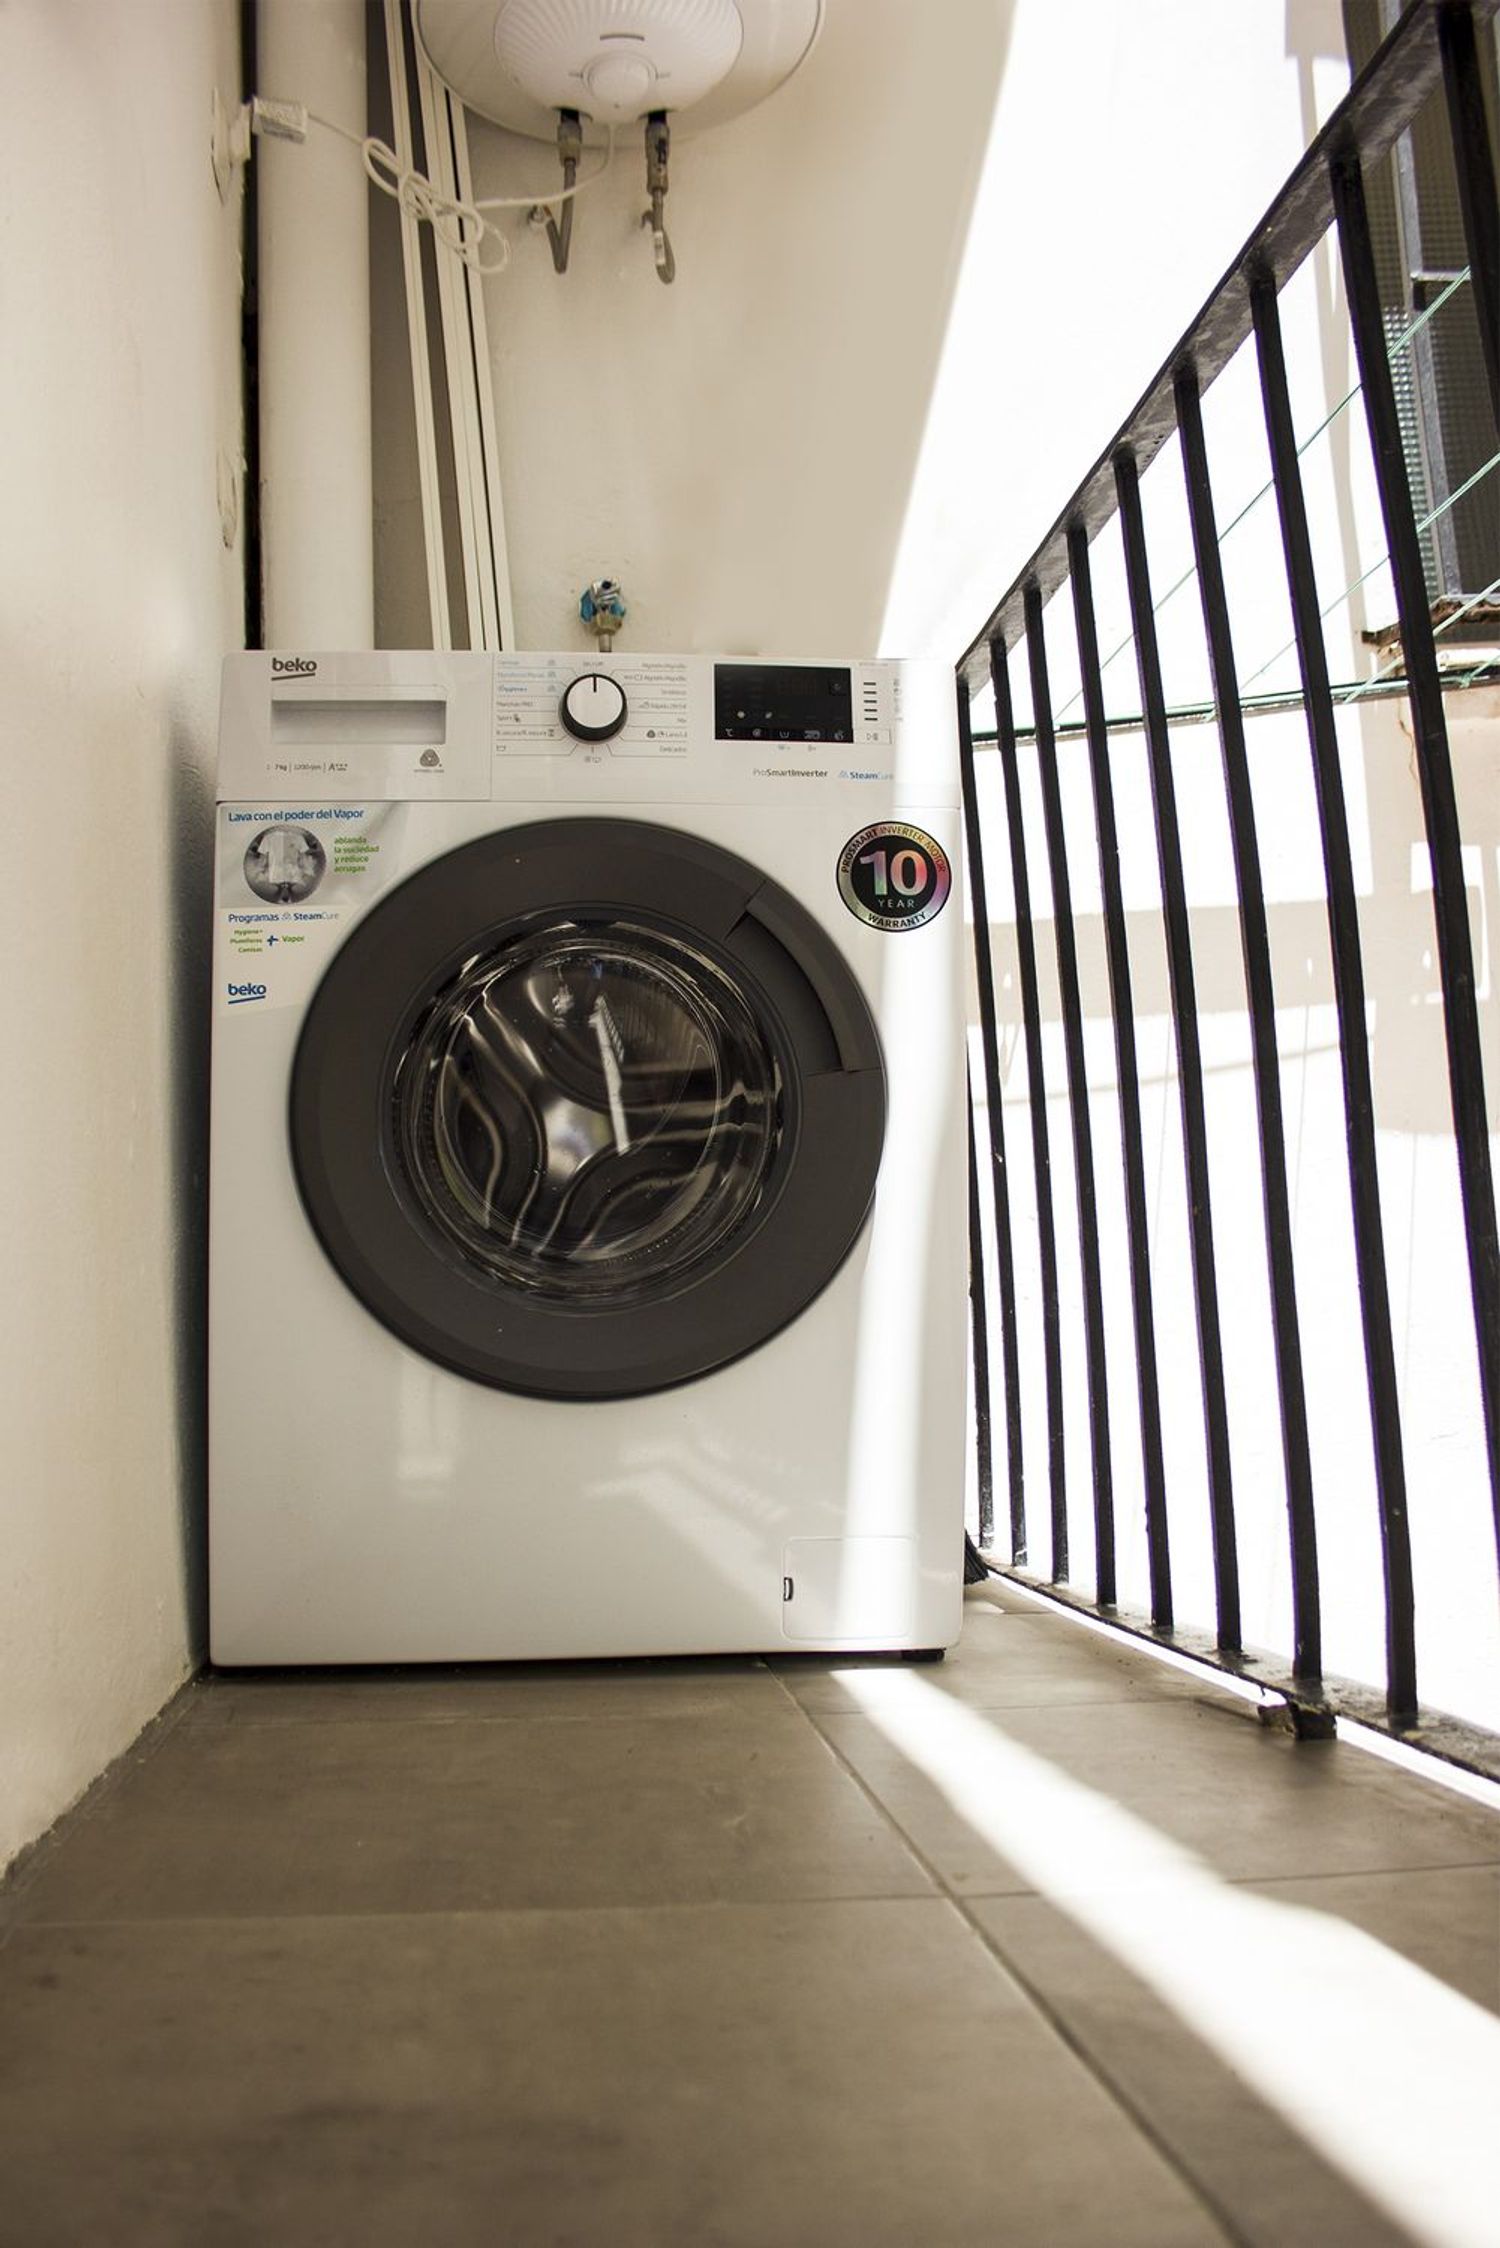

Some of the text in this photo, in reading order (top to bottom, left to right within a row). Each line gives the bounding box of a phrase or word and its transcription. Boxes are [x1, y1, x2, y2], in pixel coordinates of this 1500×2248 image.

[271, 657, 317, 673] beko
[228, 809, 364, 823] Lava con el poder del Vapor
[841, 825, 947, 874] PROSMART INVERTER MOTOR
[860, 849, 928, 896] 10
[878, 899, 915, 908] YEAR
[228, 912, 339, 925] Programas SteamCure
[867, 911, 926, 929] WARRANTY
[282, 935, 305, 943] Vapor
[228, 983, 267, 996] beko
